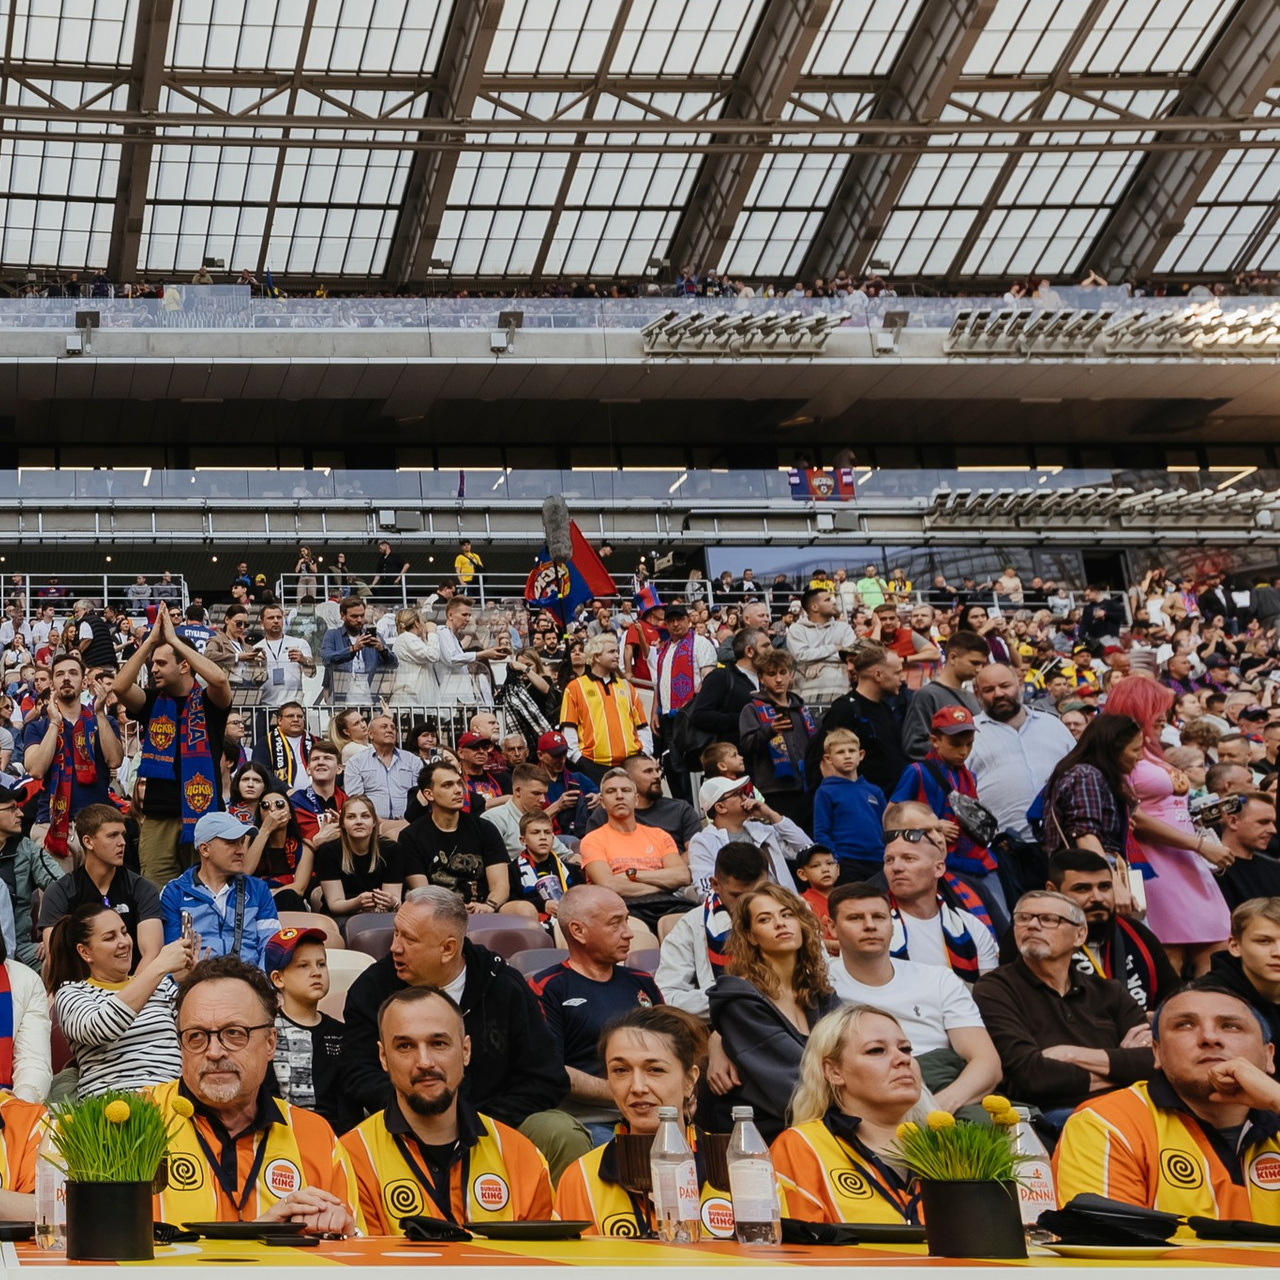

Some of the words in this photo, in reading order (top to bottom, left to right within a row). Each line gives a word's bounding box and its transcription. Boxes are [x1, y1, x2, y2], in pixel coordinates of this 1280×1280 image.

[272, 1171, 294, 1180] BURGER
[272, 1178, 294, 1188] KING
[481, 1192, 503, 1200] KING
[708, 1210, 734, 1218] BURGER
[709, 1216, 735, 1226] KING
